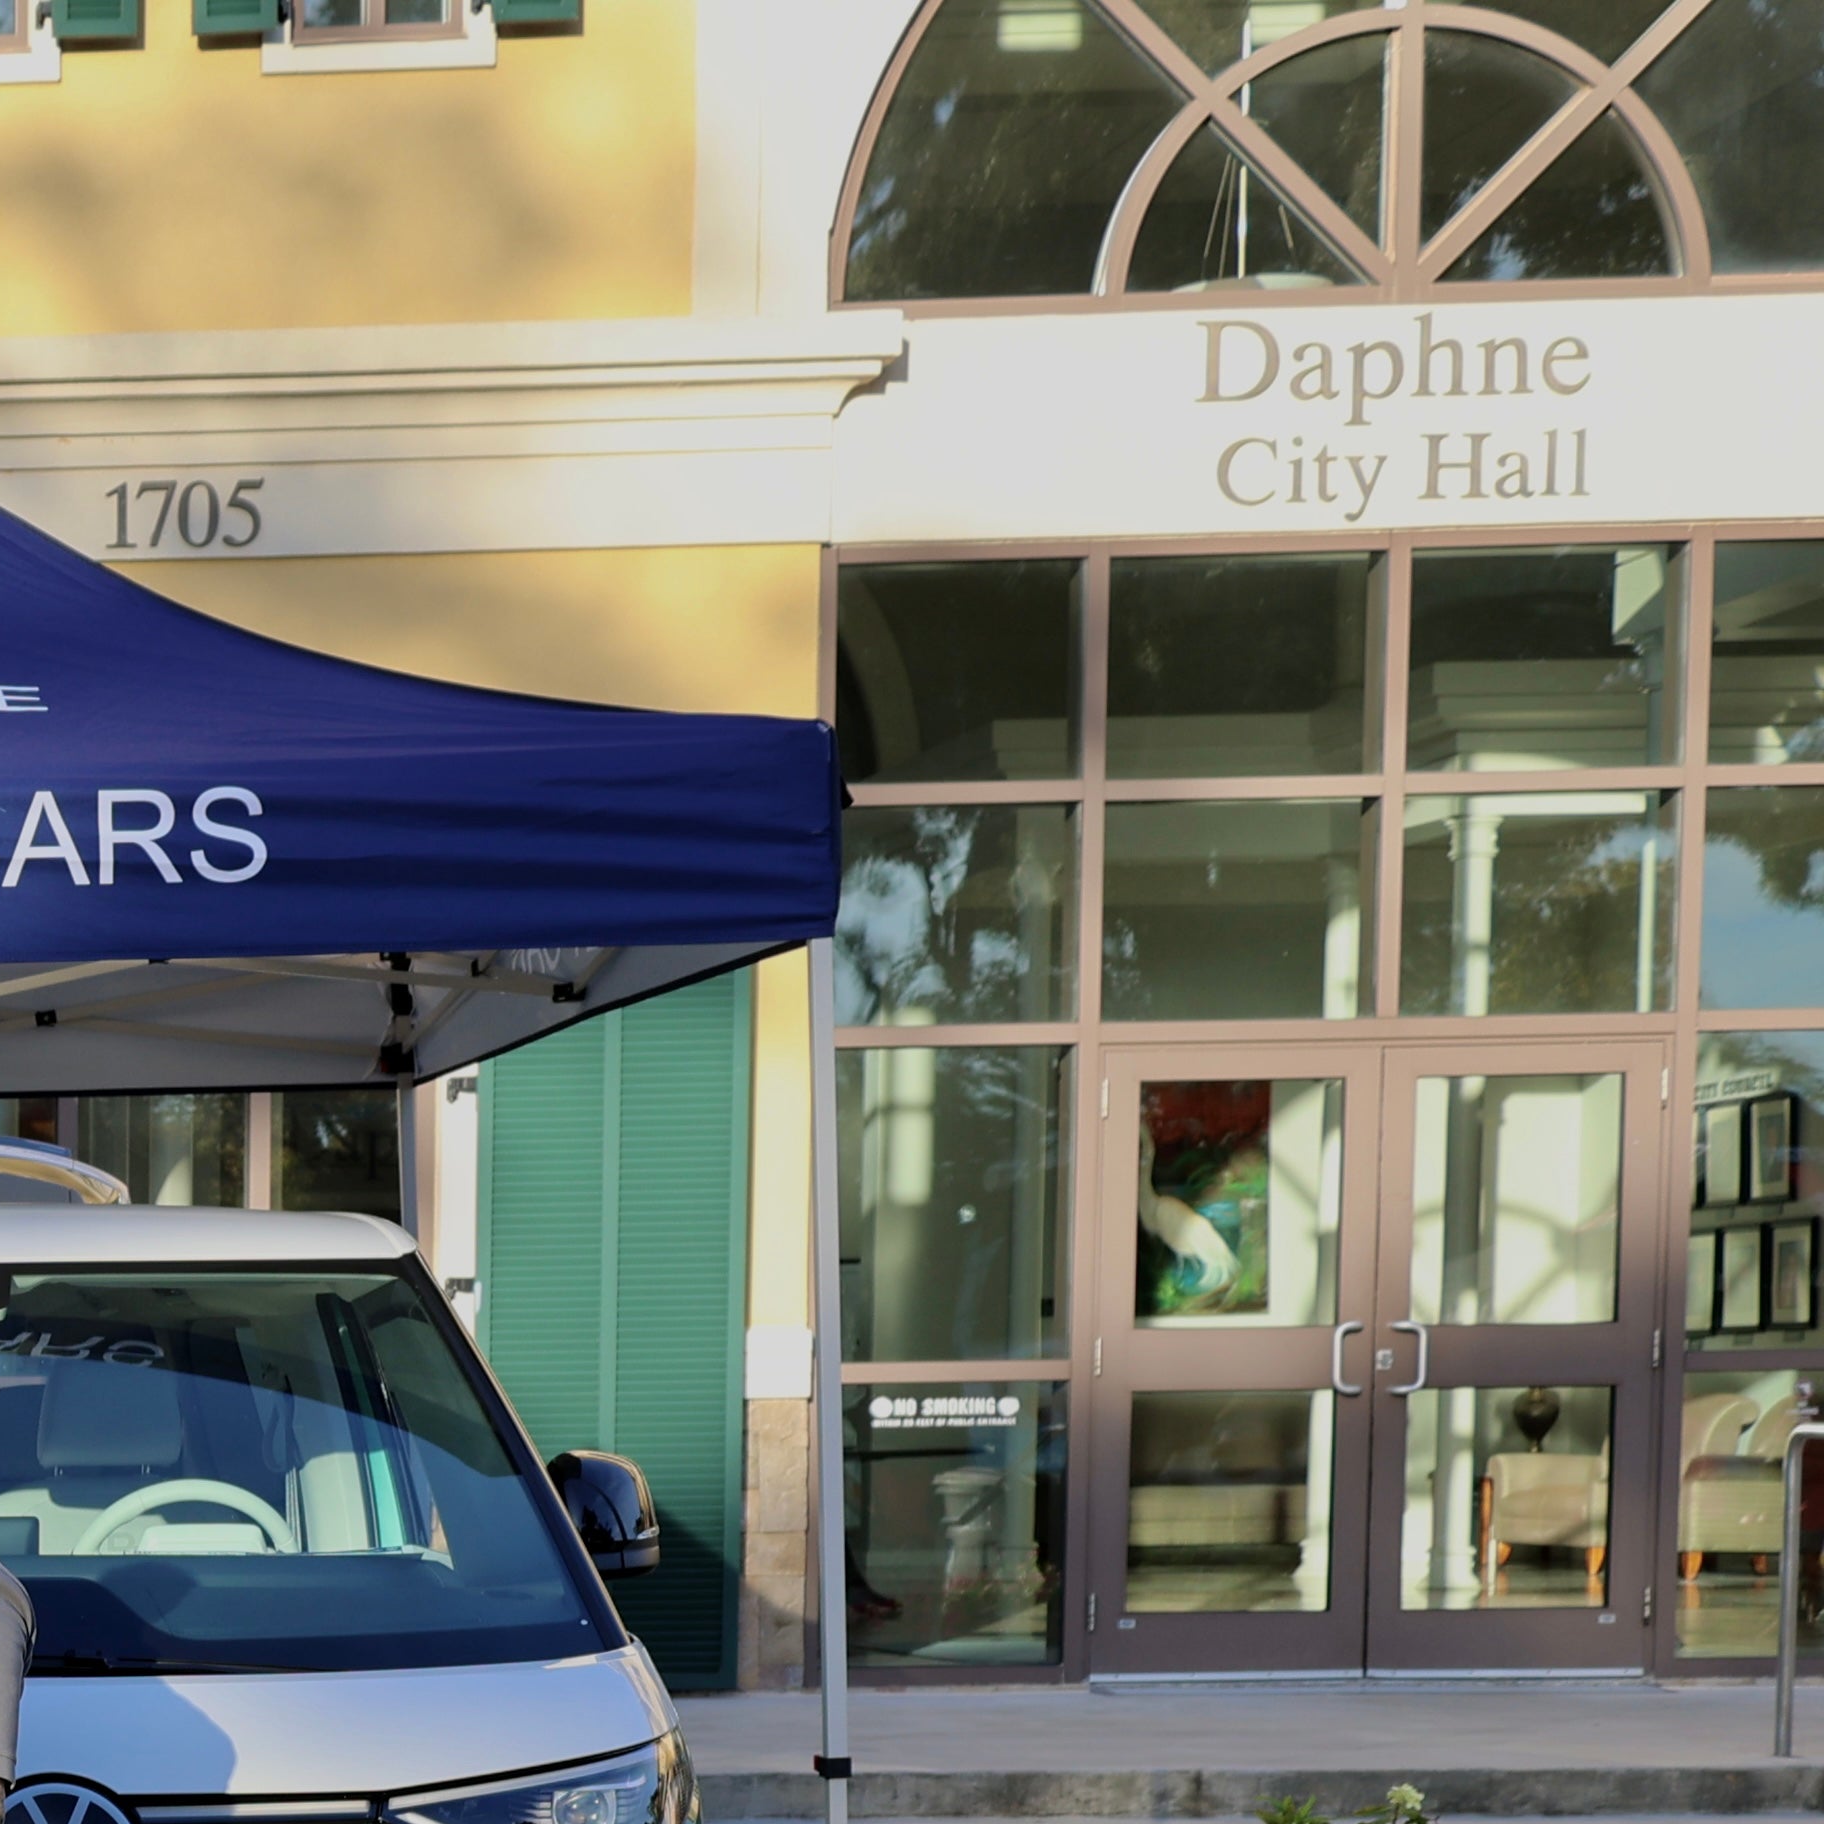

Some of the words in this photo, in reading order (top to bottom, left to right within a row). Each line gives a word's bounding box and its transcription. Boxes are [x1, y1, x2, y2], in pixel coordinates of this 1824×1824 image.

[1197, 314, 1593, 427] Daphne
[105, 477, 265, 553] 1705
[1217, 437, 1385, 520] City
[1419, 428, 1587, 500] Hall
[893, 1396, 917, 1416] NO
[921, 1396, 996, 1416] SMOKING
